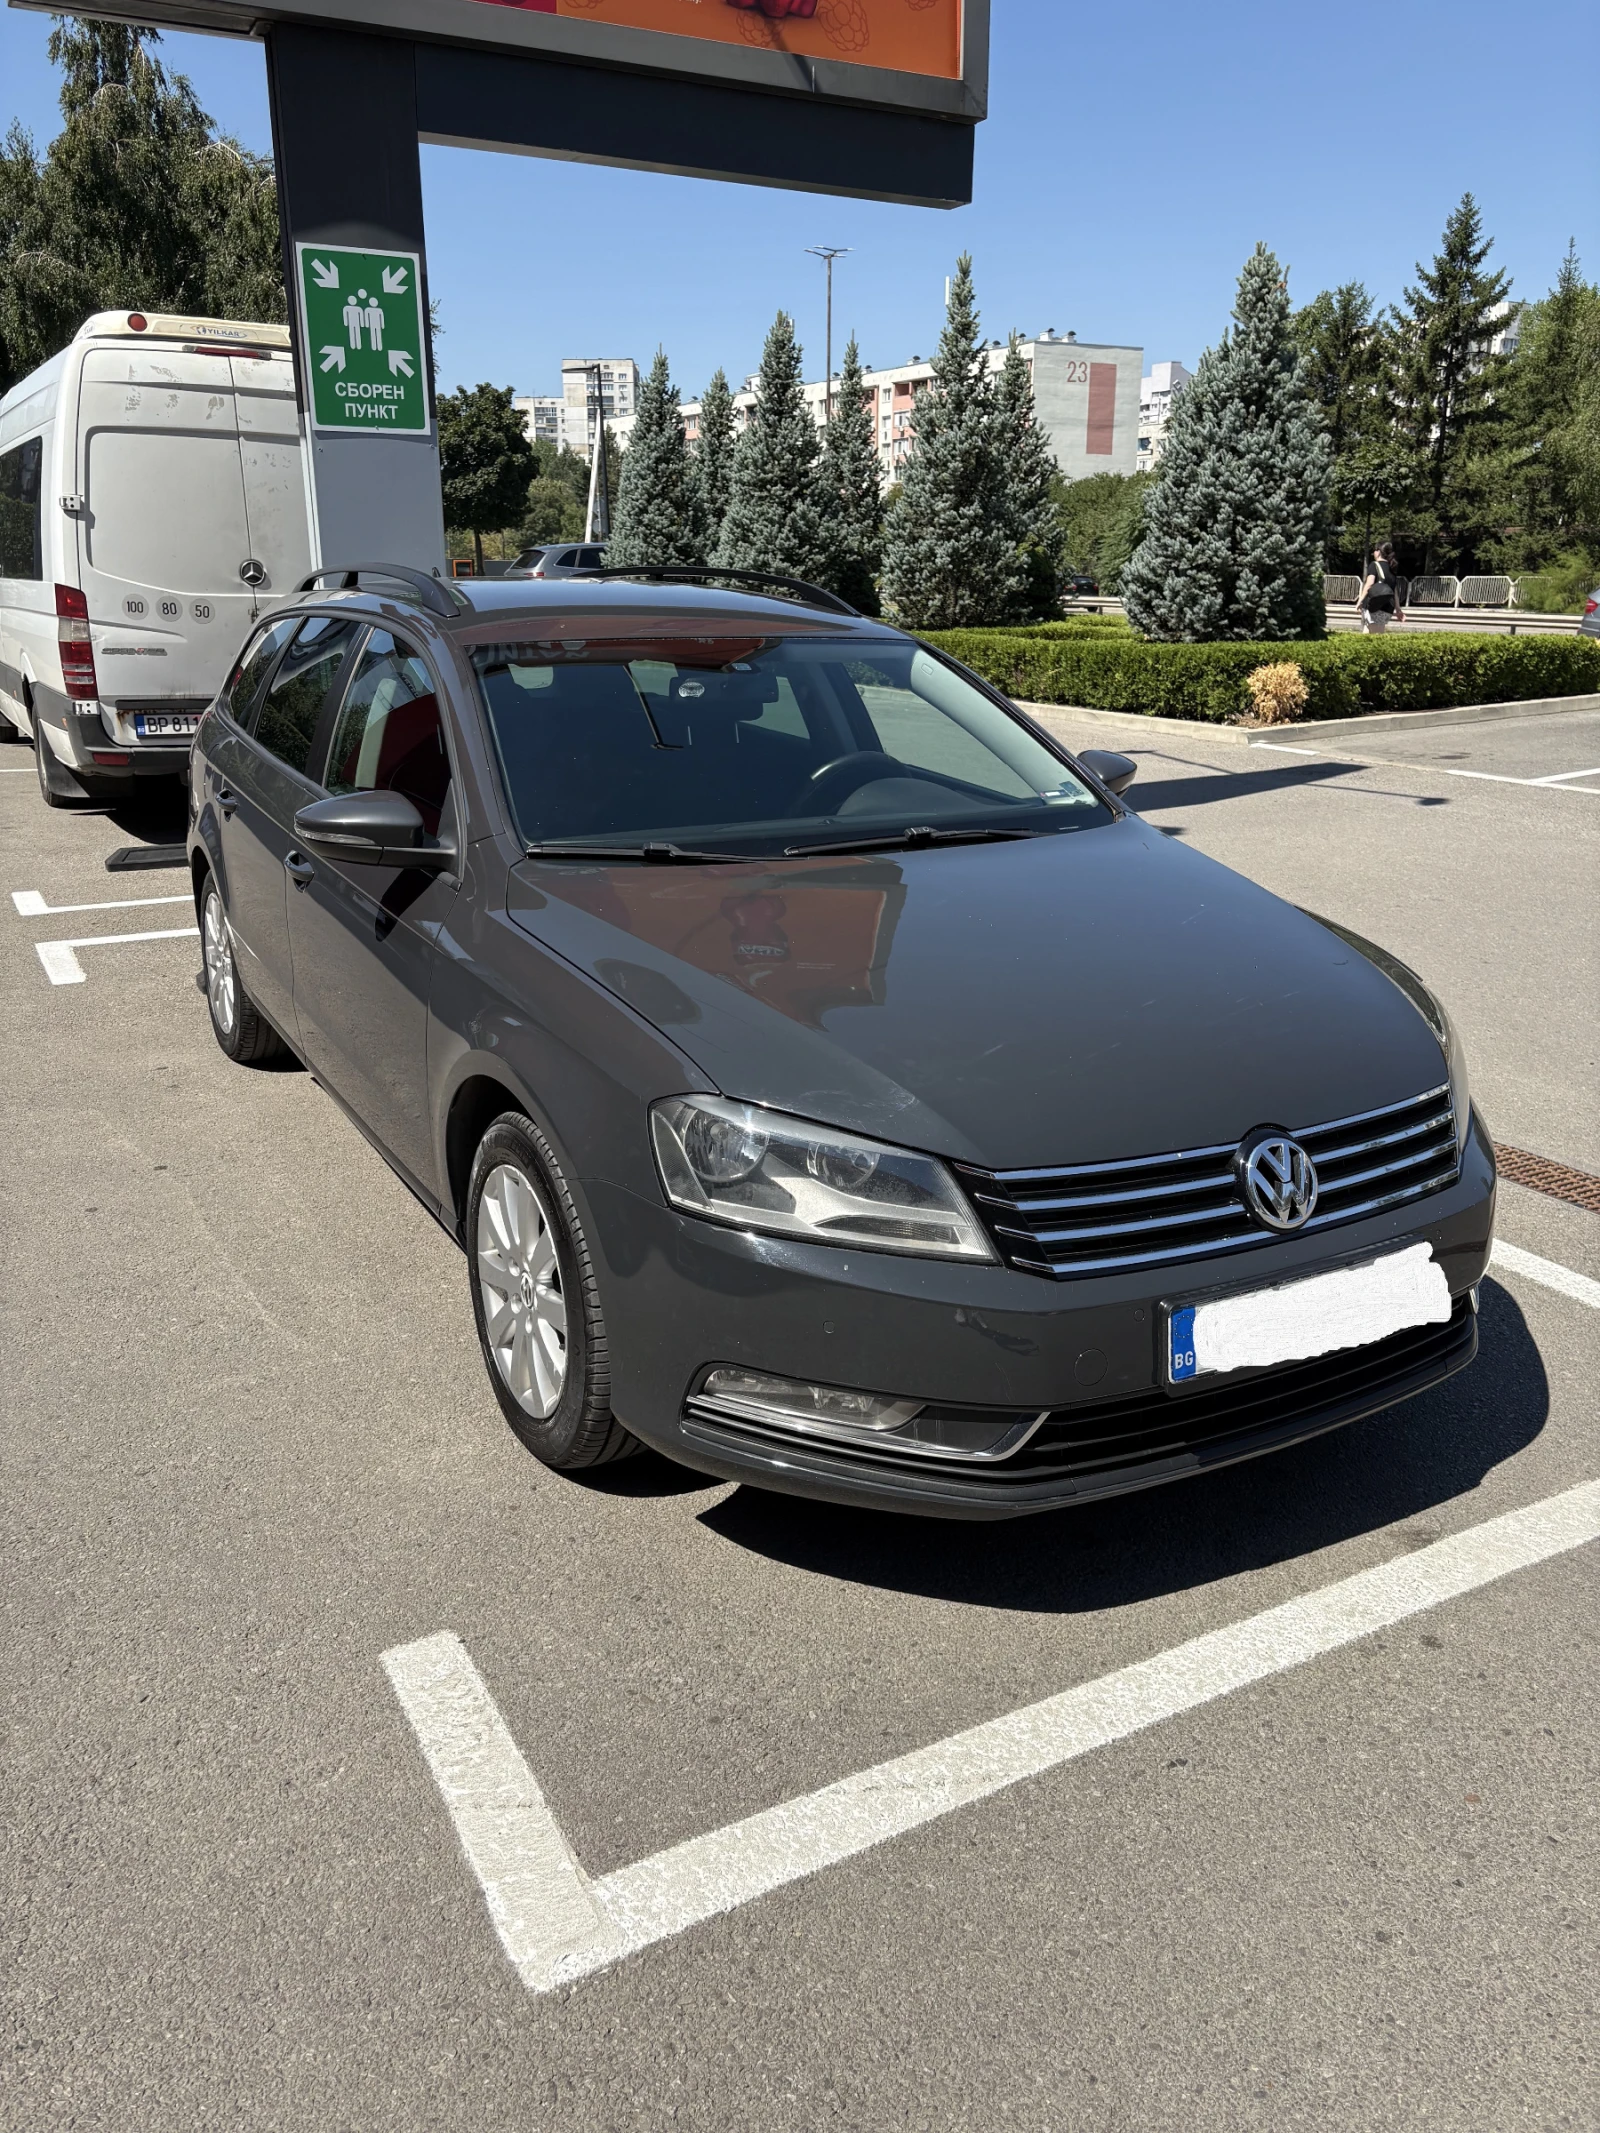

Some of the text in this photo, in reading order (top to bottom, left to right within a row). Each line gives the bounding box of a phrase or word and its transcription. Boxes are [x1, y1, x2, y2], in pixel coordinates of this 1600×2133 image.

[207, 328, 240, 337] YILKAR
[1067, 361, 1088, 382] 23
[335, 381, 405, 400] СБОРЕН
[344, 402, 399, 420] ПУНКТ
[126, 601, 144, 614] 100
[162, 602, 178, 615] 80
[195, 605, 210, 618] 50
[1174, 1351, 1194, 1370] BG
